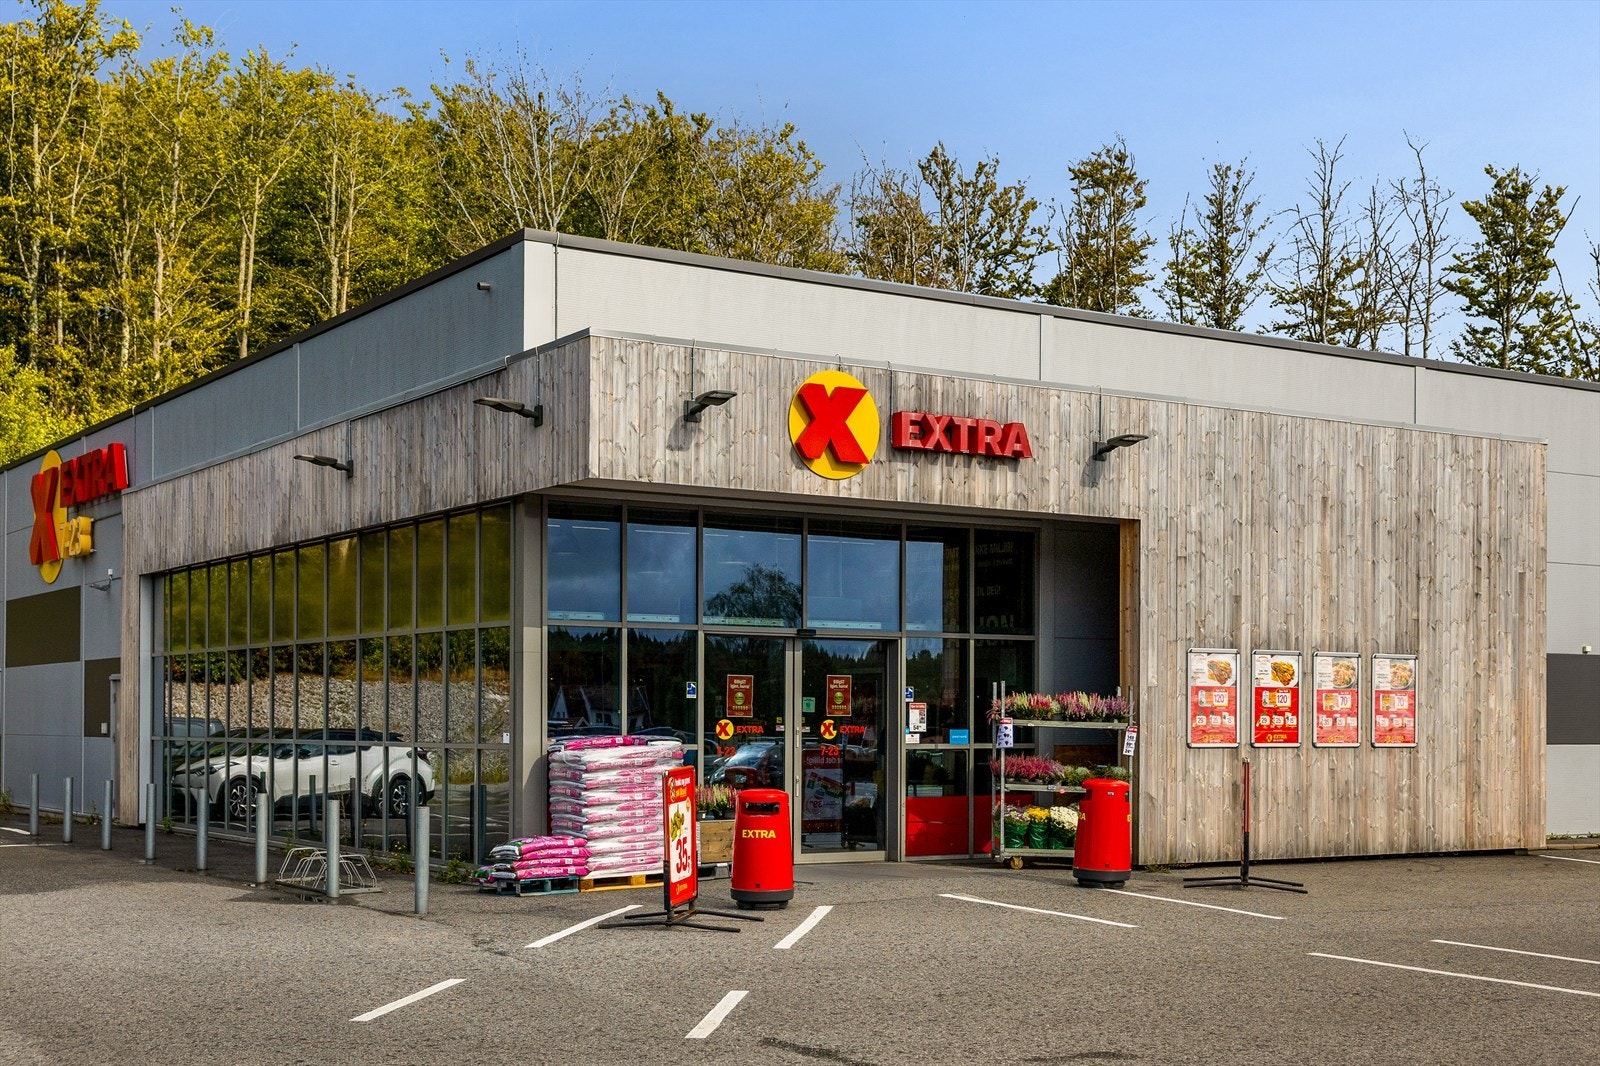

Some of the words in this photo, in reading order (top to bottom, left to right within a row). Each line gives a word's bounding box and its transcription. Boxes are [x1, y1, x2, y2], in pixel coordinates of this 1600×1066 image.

[794, 383, 870, 464] X
[892, 411, 1033, 459] EXTRA
[29, 467, 60, 565] X
[60, 442, 129, 508] EXTRA
[736, 725, 764, 734] EXTRA
[839, 725, 865, 734] EXTRA
[820, 746, 839, 756] 7-23
[741, 829, 777, 839] EXTRA
